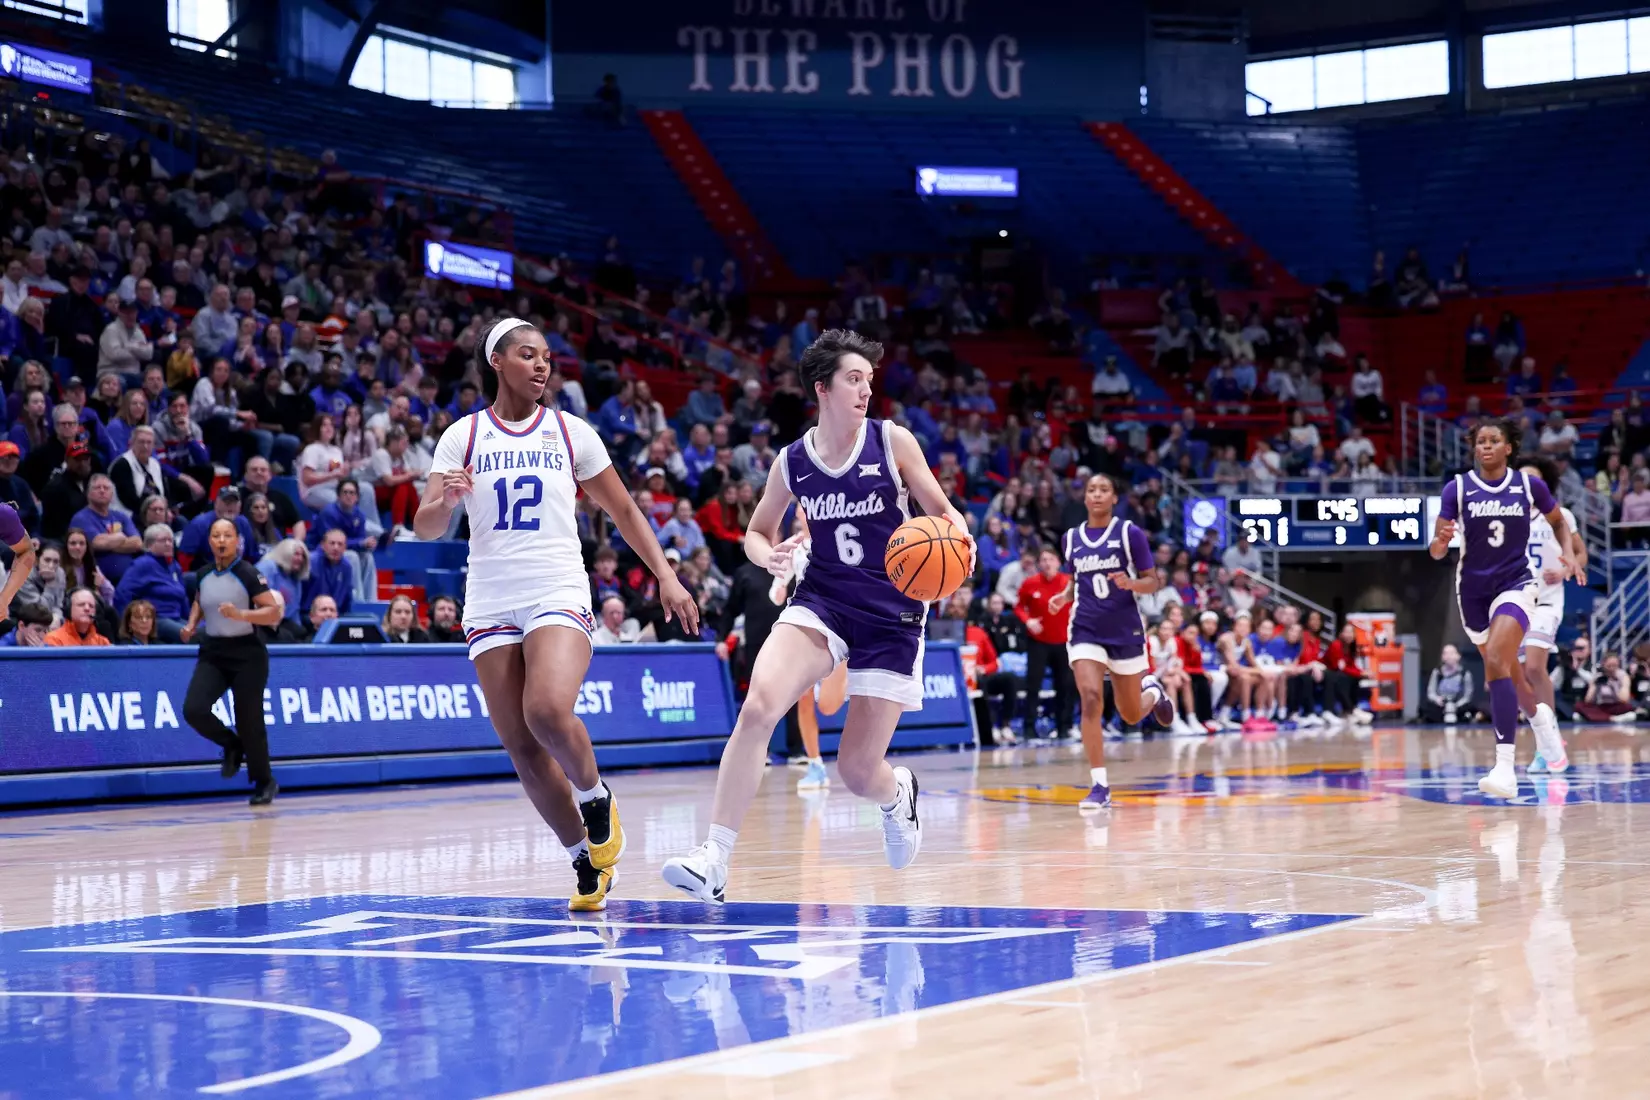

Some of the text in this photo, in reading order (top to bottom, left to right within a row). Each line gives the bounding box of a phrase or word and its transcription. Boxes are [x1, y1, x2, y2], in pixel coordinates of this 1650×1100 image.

[676, 25, 1024, 99] THE PHOG
[475, 451, 564, 474] JAYHAWKS
[493, 475, 543, 531] 12
[801, 490, 885, 520] Wildcats
[1467, 500, 1524, 518] Wildcats
[834, 523, 864, 566] 6
[1488, 520, 1505, 548] 3
[1073, 554, 1121, 573] Wildcats
[1092, 572, 1110, 599] 0
[50, 692, 145, 732] HAVE
[154, 691, 180, 728] A
[279, 686, 362, 724] PLAN
[365, 684, 471, 721] BEFORE
